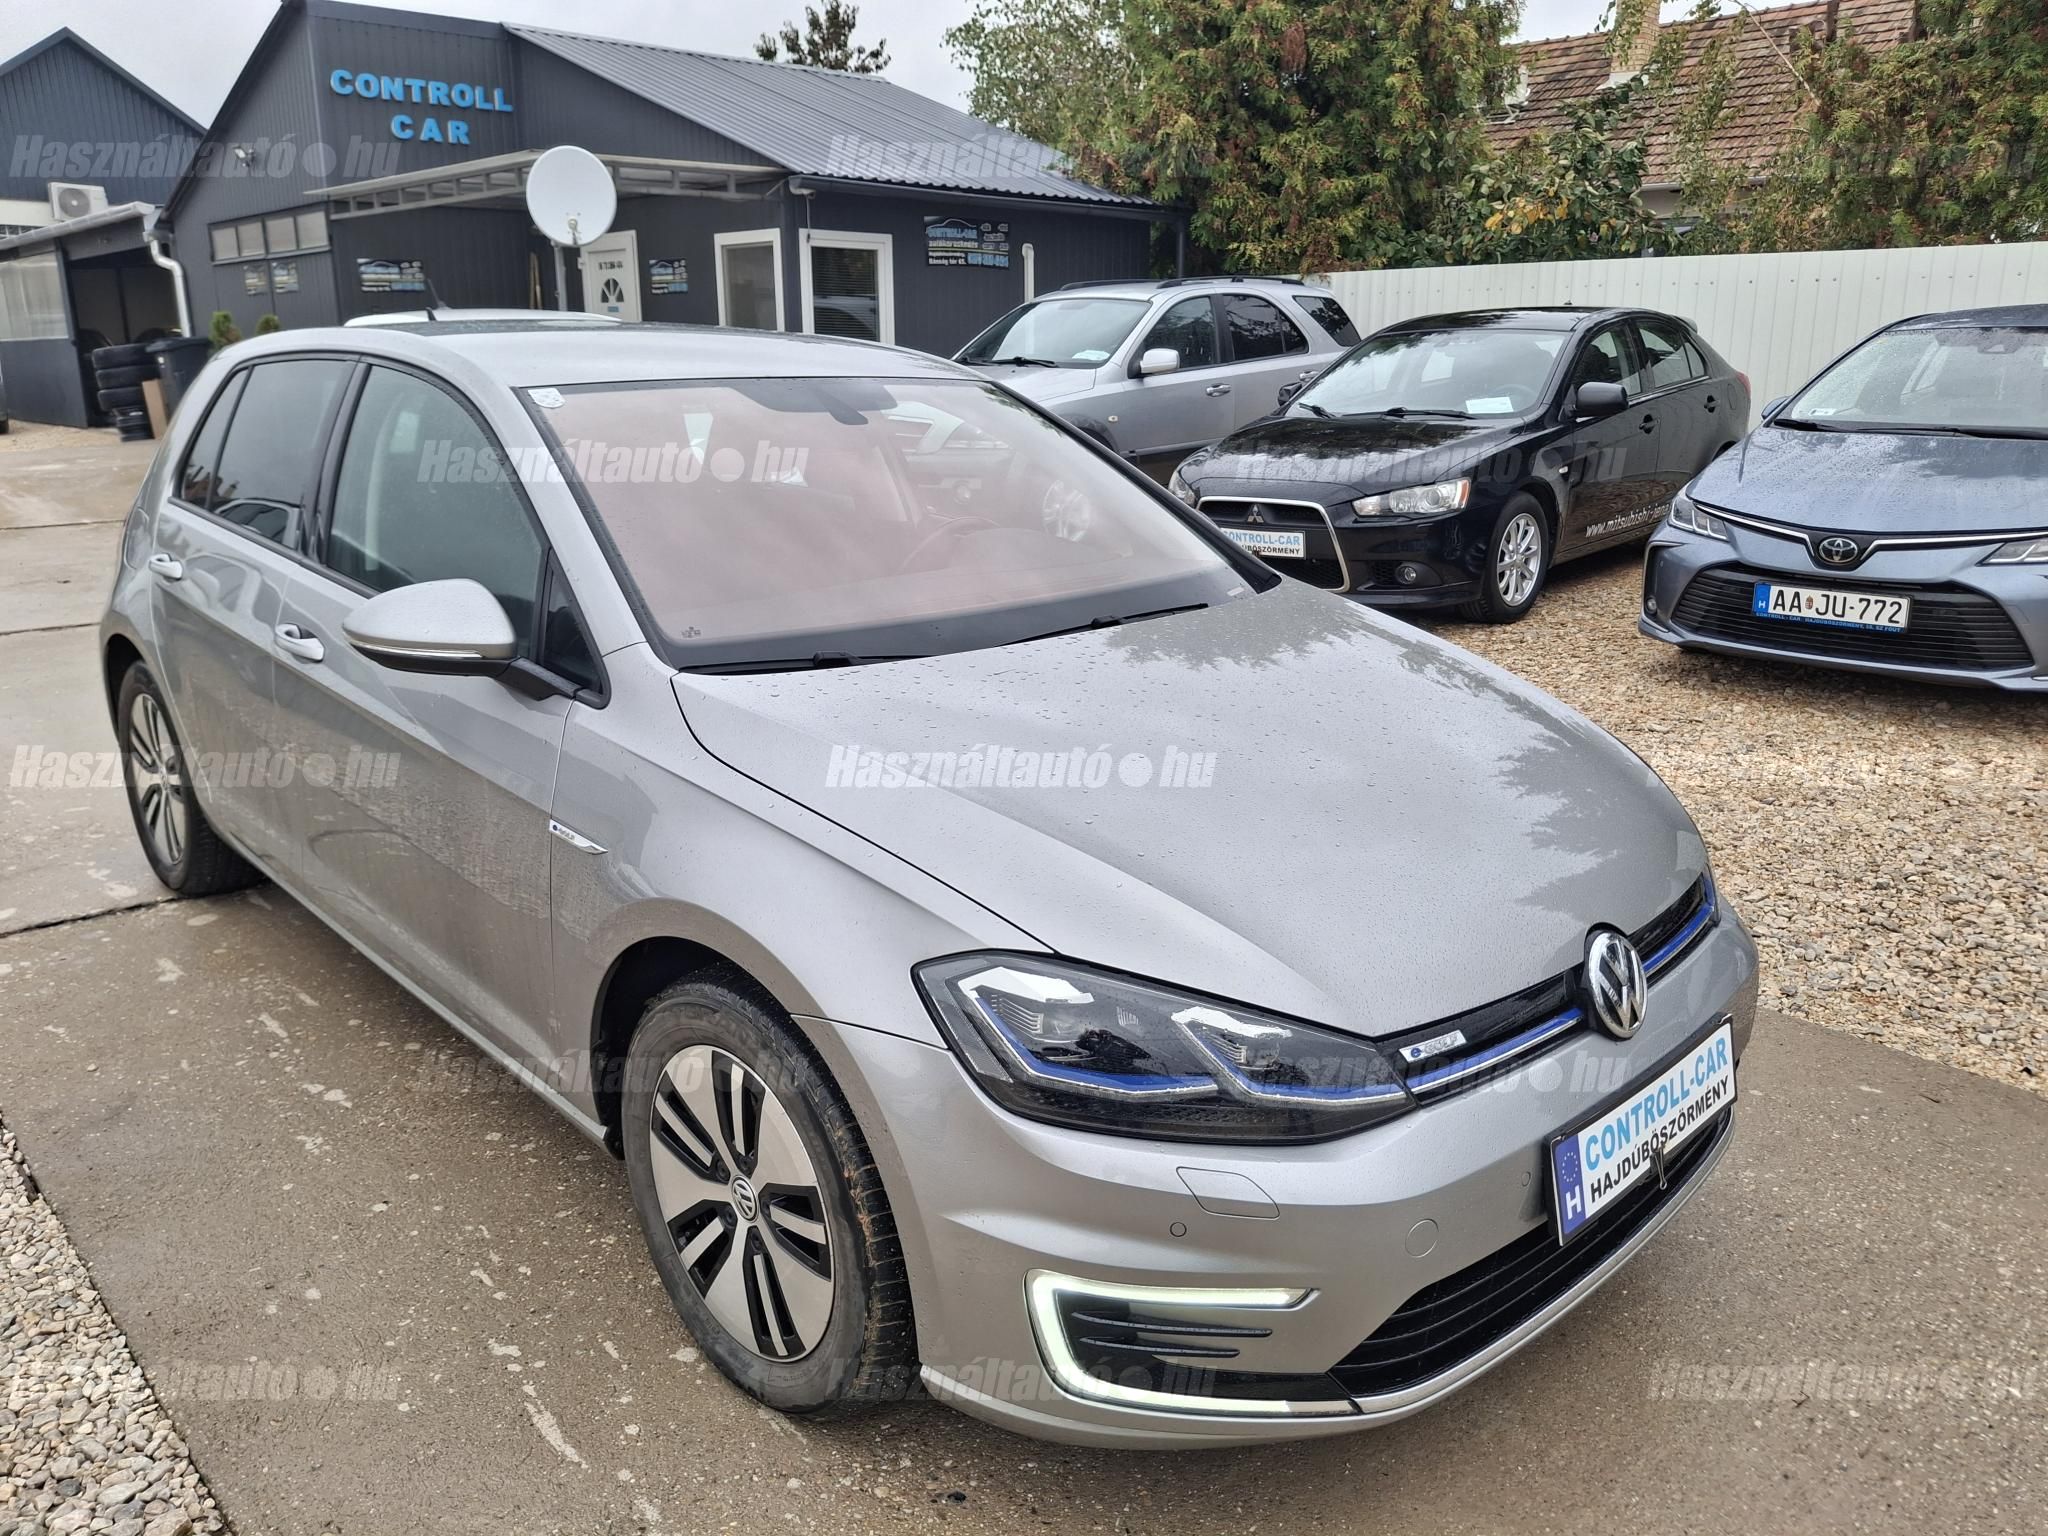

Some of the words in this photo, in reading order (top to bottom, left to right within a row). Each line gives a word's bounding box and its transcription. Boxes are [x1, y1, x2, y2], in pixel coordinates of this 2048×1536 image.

[330, 69, 514, 113] CONTROLL
[390, 114, 471, 146] CAR
[1758, 599, 1767, 610] H
[1772, 589, 1802, 614] AA
[1815, 593, 1903, 625] JU-772
[1585, 1036, 1728, 1172] CONTROLL-CAR
[1564, 1185, 1582, 1221] H
